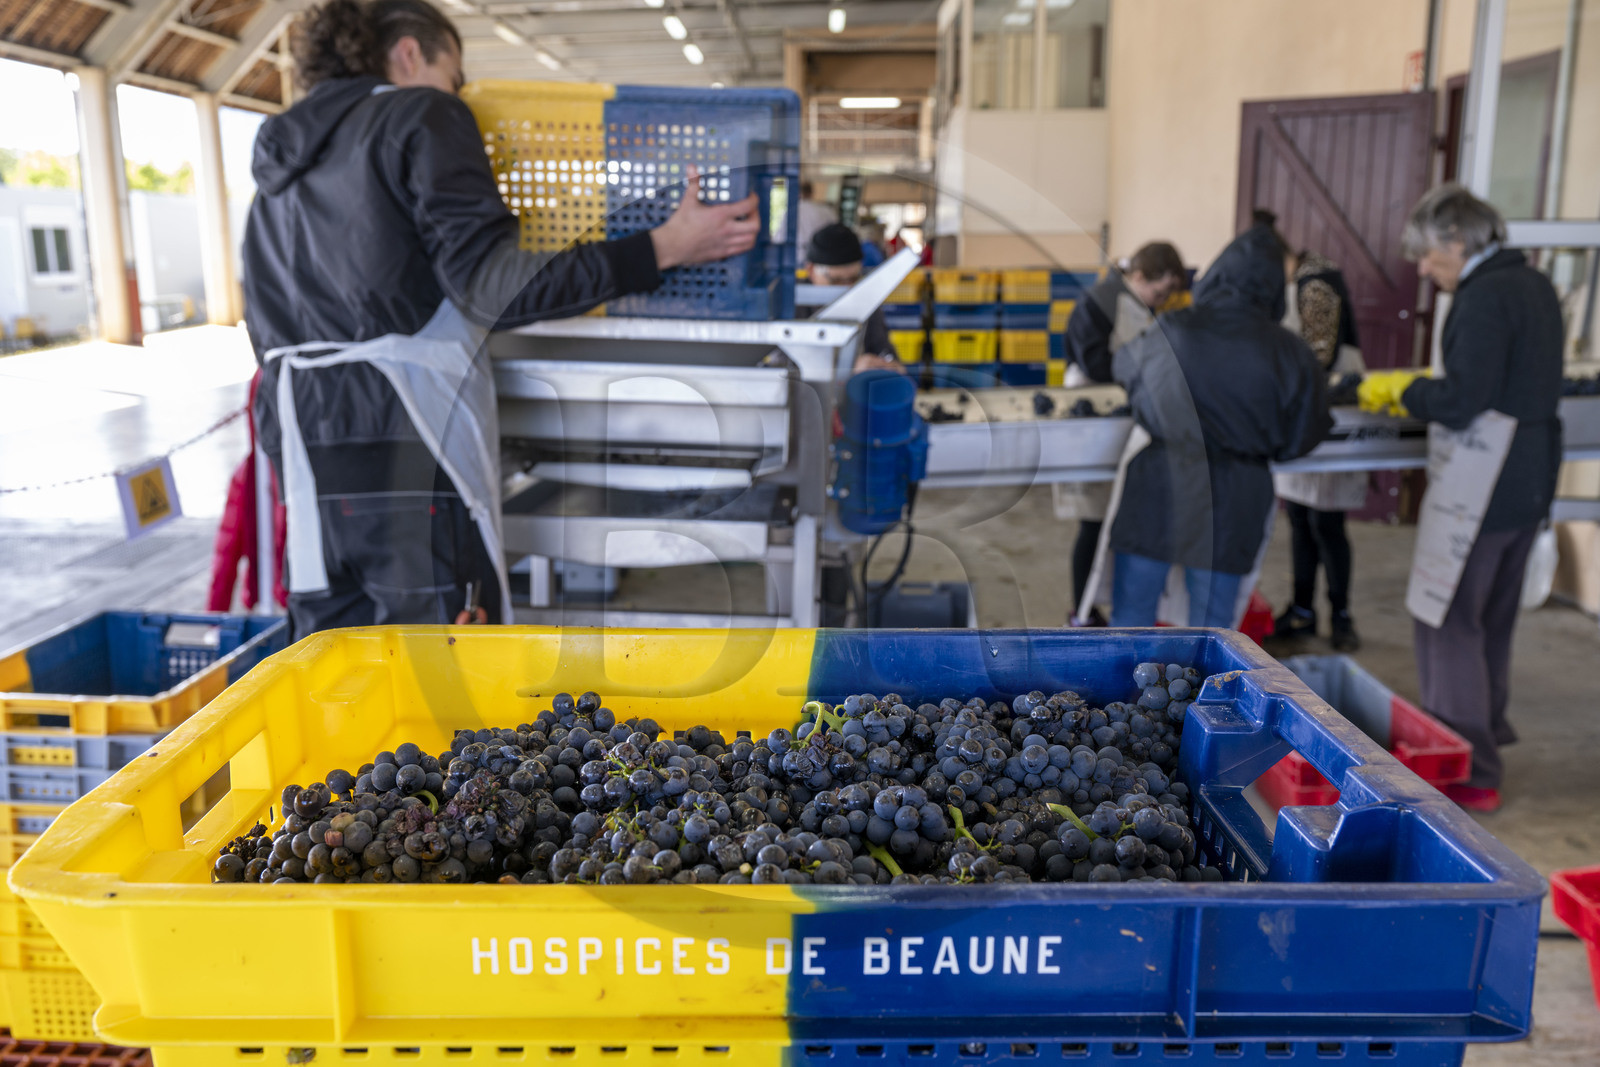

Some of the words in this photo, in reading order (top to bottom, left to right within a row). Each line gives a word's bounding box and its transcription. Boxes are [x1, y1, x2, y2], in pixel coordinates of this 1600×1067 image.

[471, 937, 731, 976] HOSPICES
[765, 936, 827, 976] DE
[862, 935, 1063, 976] BEAUNE
